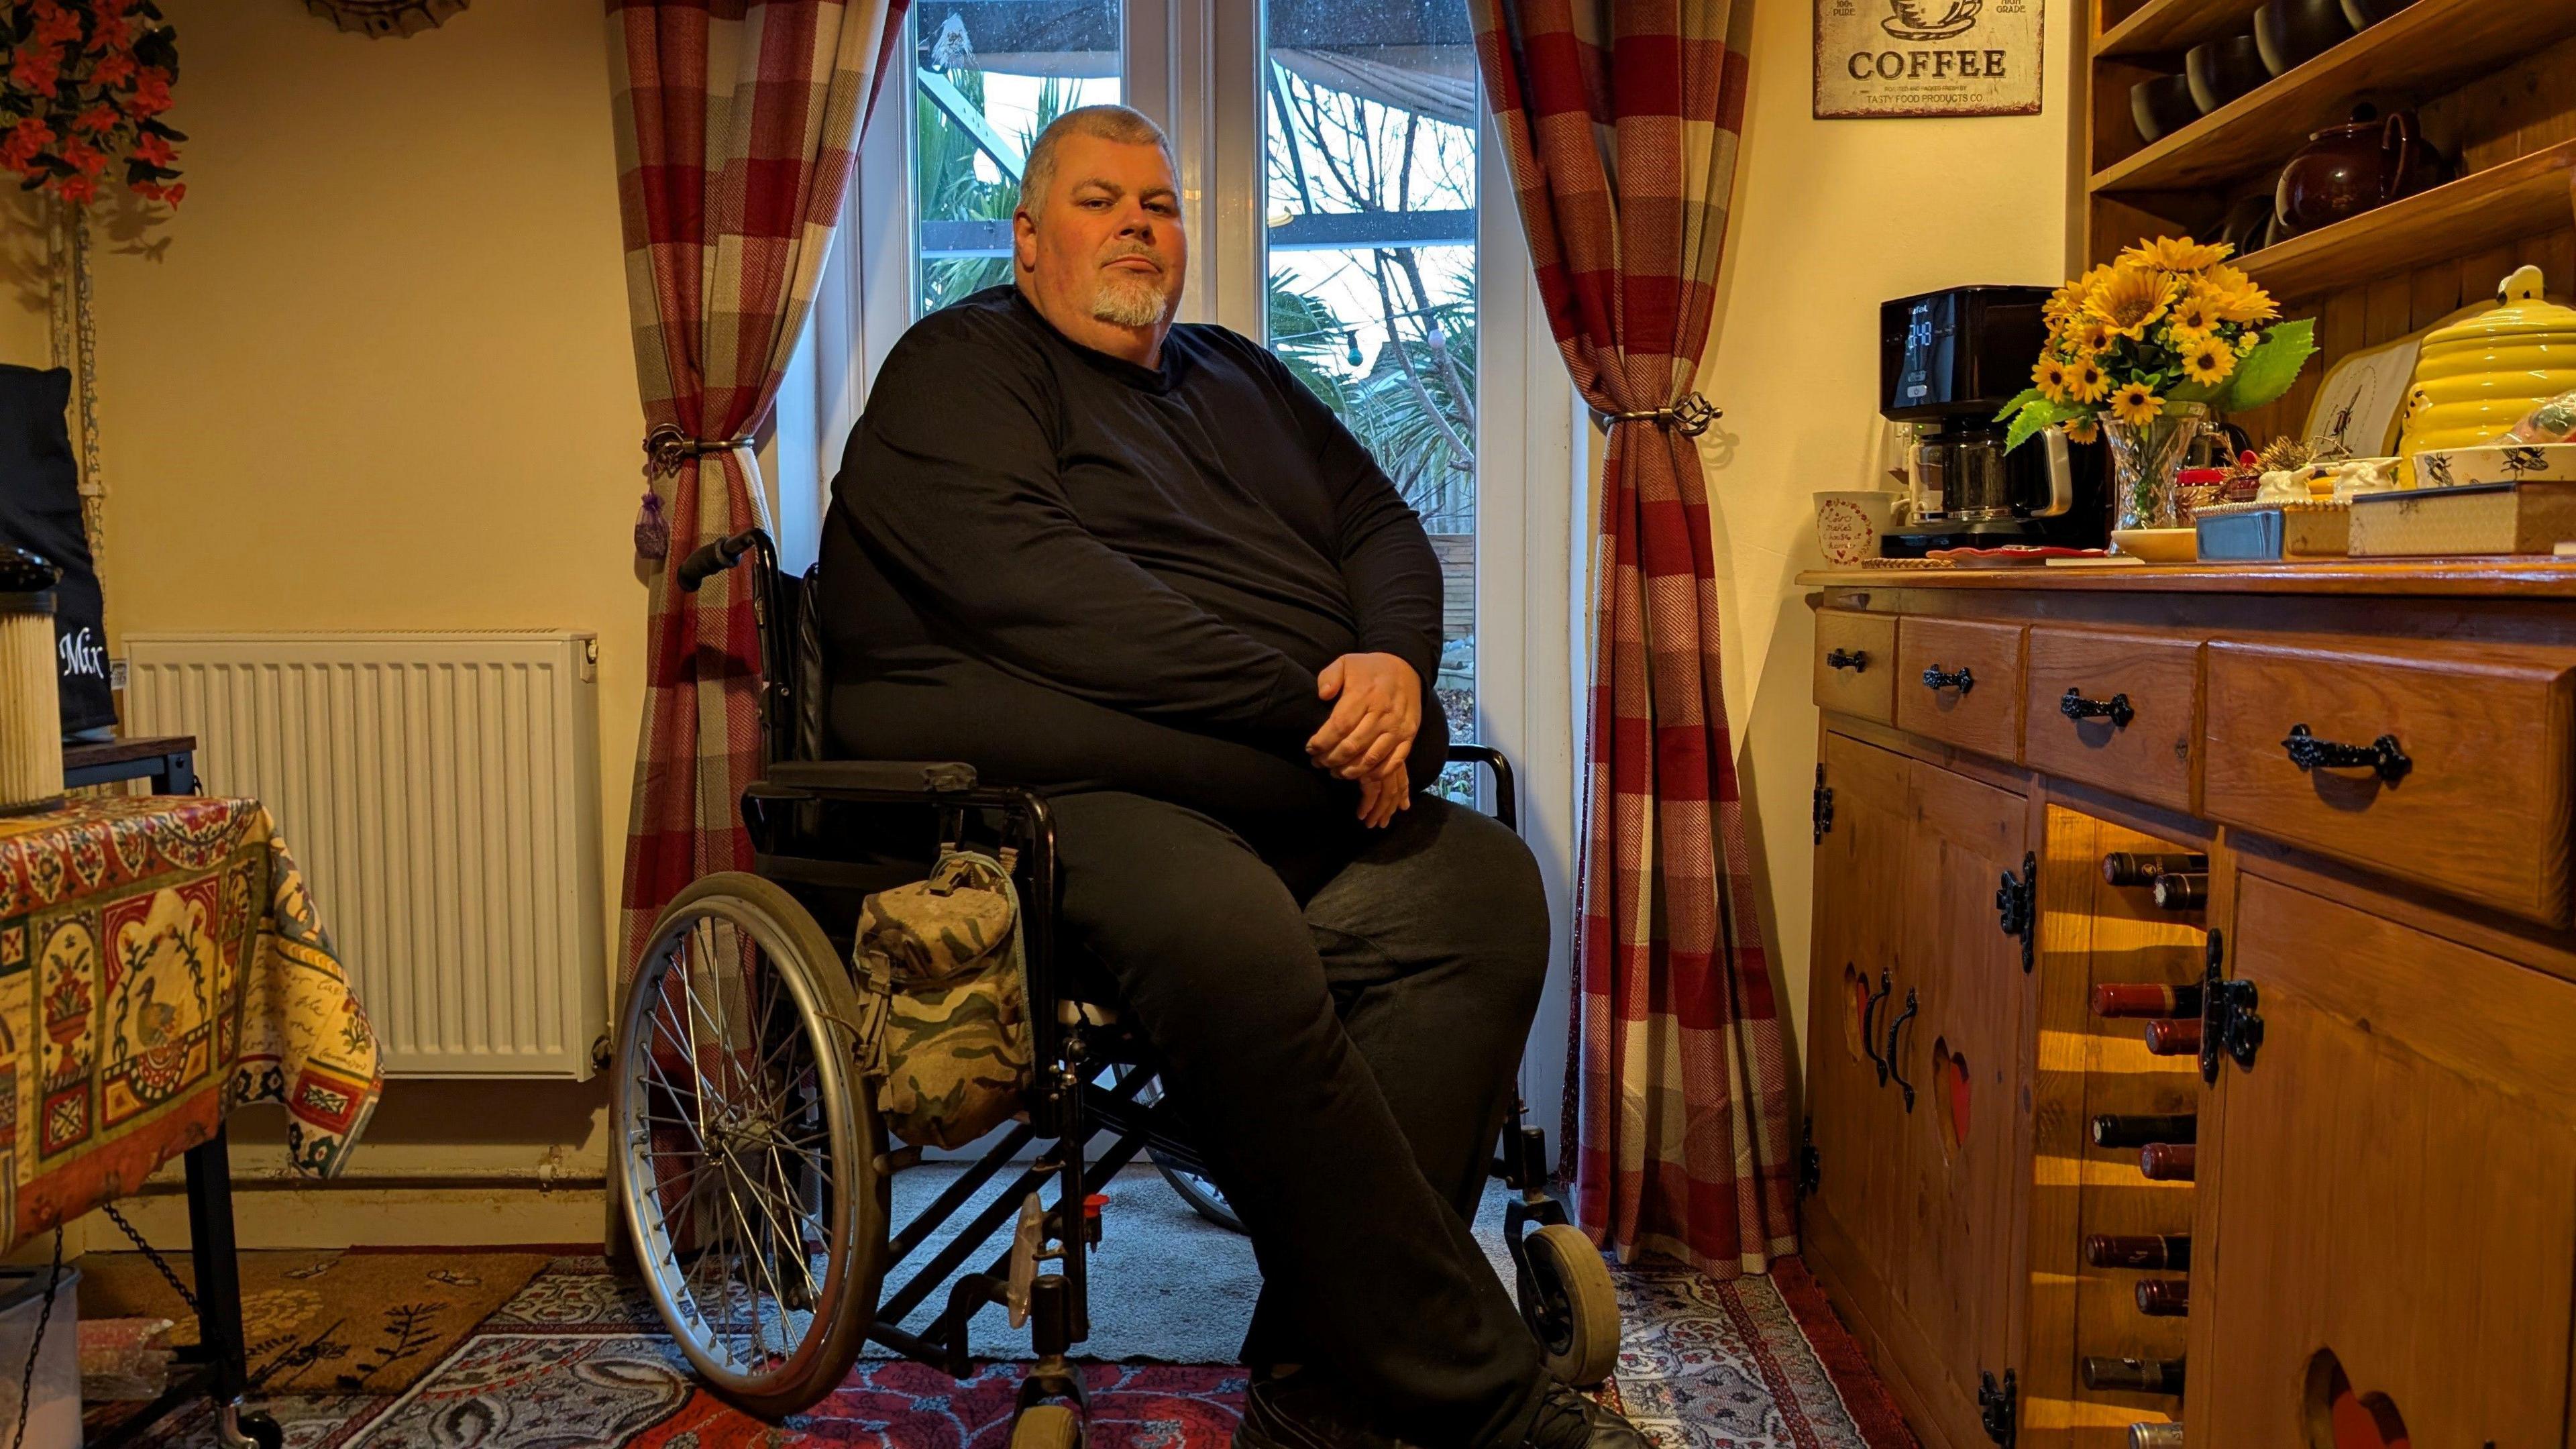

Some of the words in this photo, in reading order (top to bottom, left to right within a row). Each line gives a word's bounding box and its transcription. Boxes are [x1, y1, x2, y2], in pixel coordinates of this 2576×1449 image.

[1833, 8, 1856, 16] PURE
[1848, 50, 2006, 80] COFFEE
[1867, 95, 1894, 103] TASTY
[1896, 95, 1919, 103] FOOD
[1922, 94, 1968, 103] PRODUCTS
